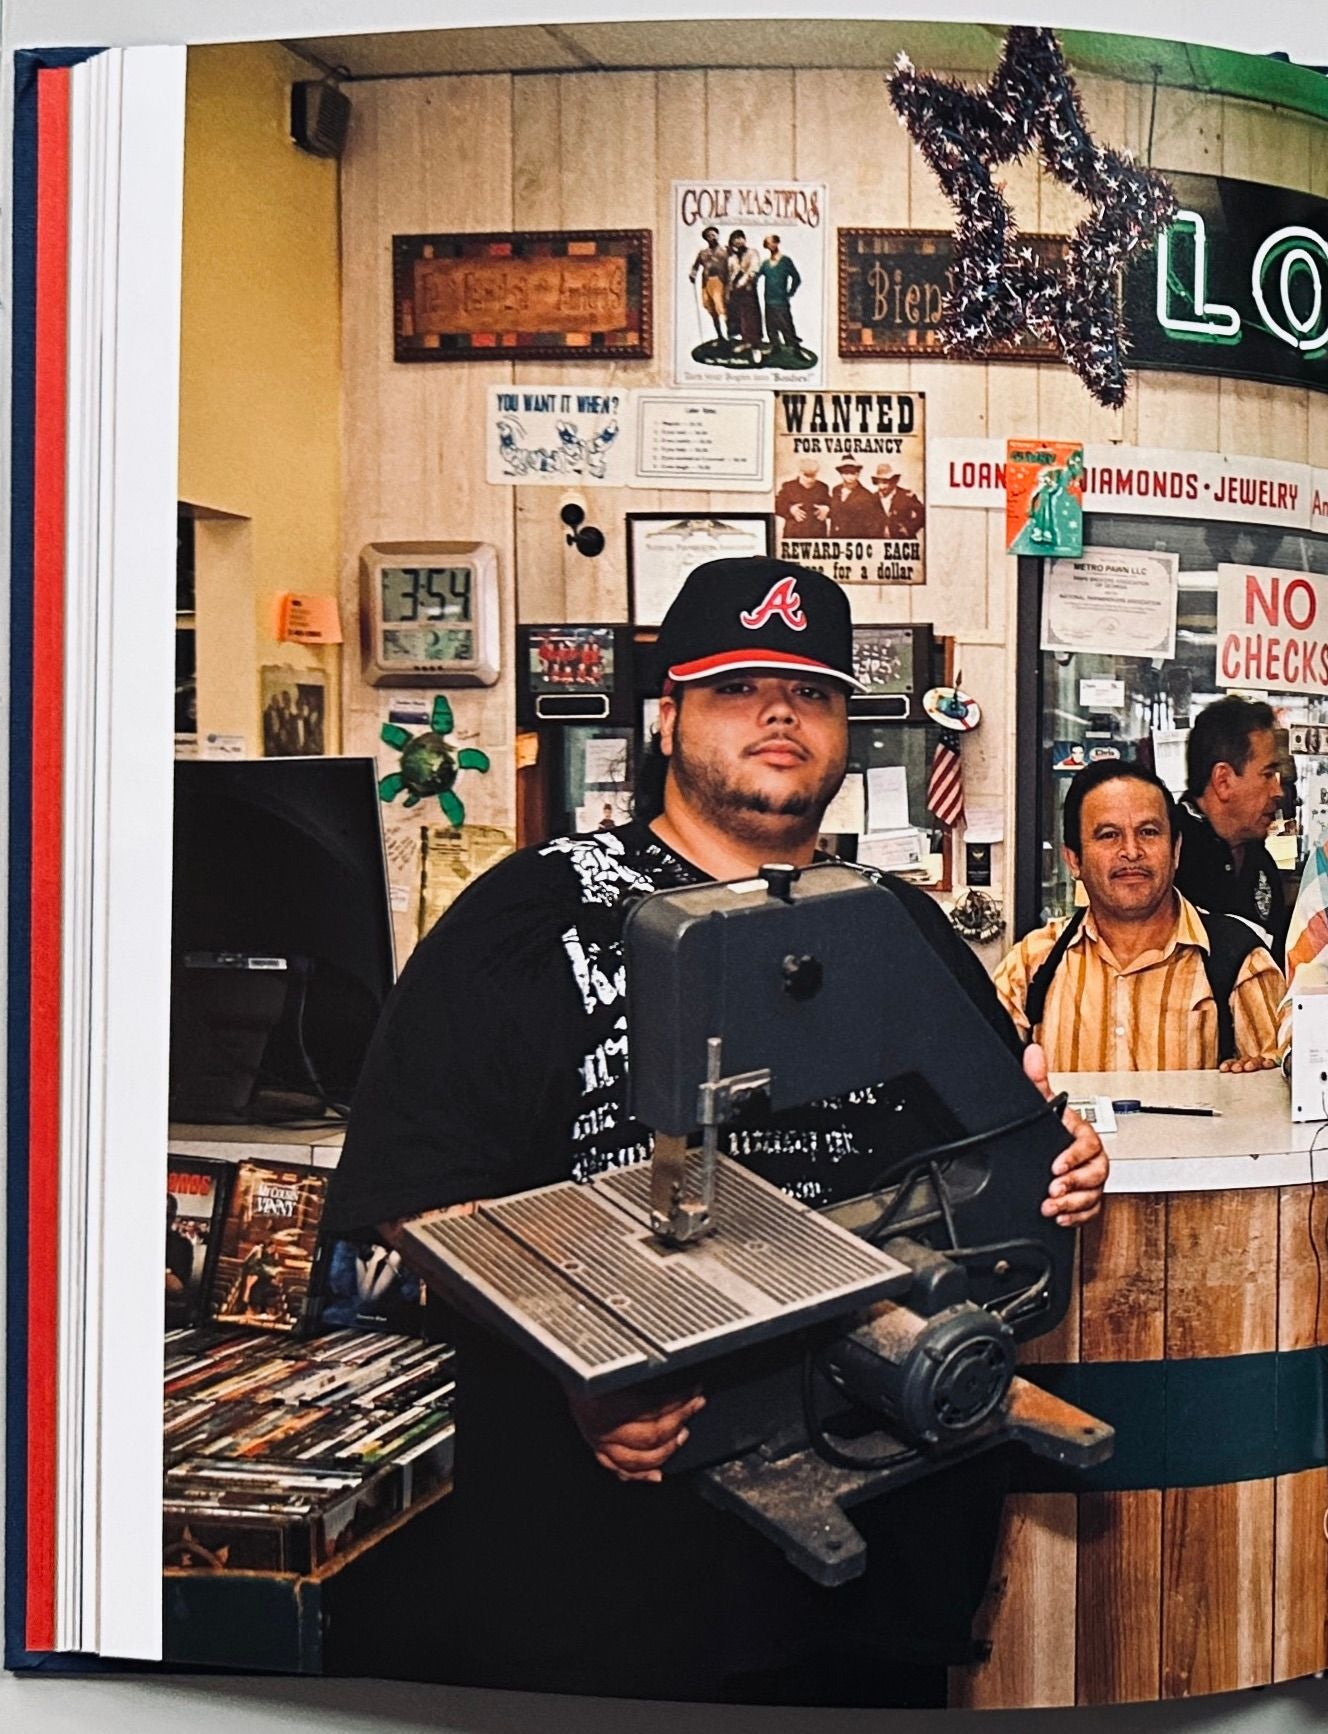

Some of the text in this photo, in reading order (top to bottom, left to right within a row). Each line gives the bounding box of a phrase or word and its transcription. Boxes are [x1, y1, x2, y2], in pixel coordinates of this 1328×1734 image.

[682, 188, 821, 229] GOLF MASTERS
[496, 393, 620, 416] YOU WANT IT WHEN?
[782, 393, 915, 434] WANTED
[793, 437, 904, 454] FOR VAGRANCY
[1214, 479, 1298, 511] JEWELRY
[883, 542, 921, 561] EACH
[833, 561, 852, 580] for
[860, 566, 869, 580] a
[877, 562, 914, 581] dollar
[1073, 562, 1148, 576] METRO PAWN LLC
[400, 567, 472, 622] 3:54
[740, 576, 807, 631] A
[1244, 574, 1317, 630] NO
